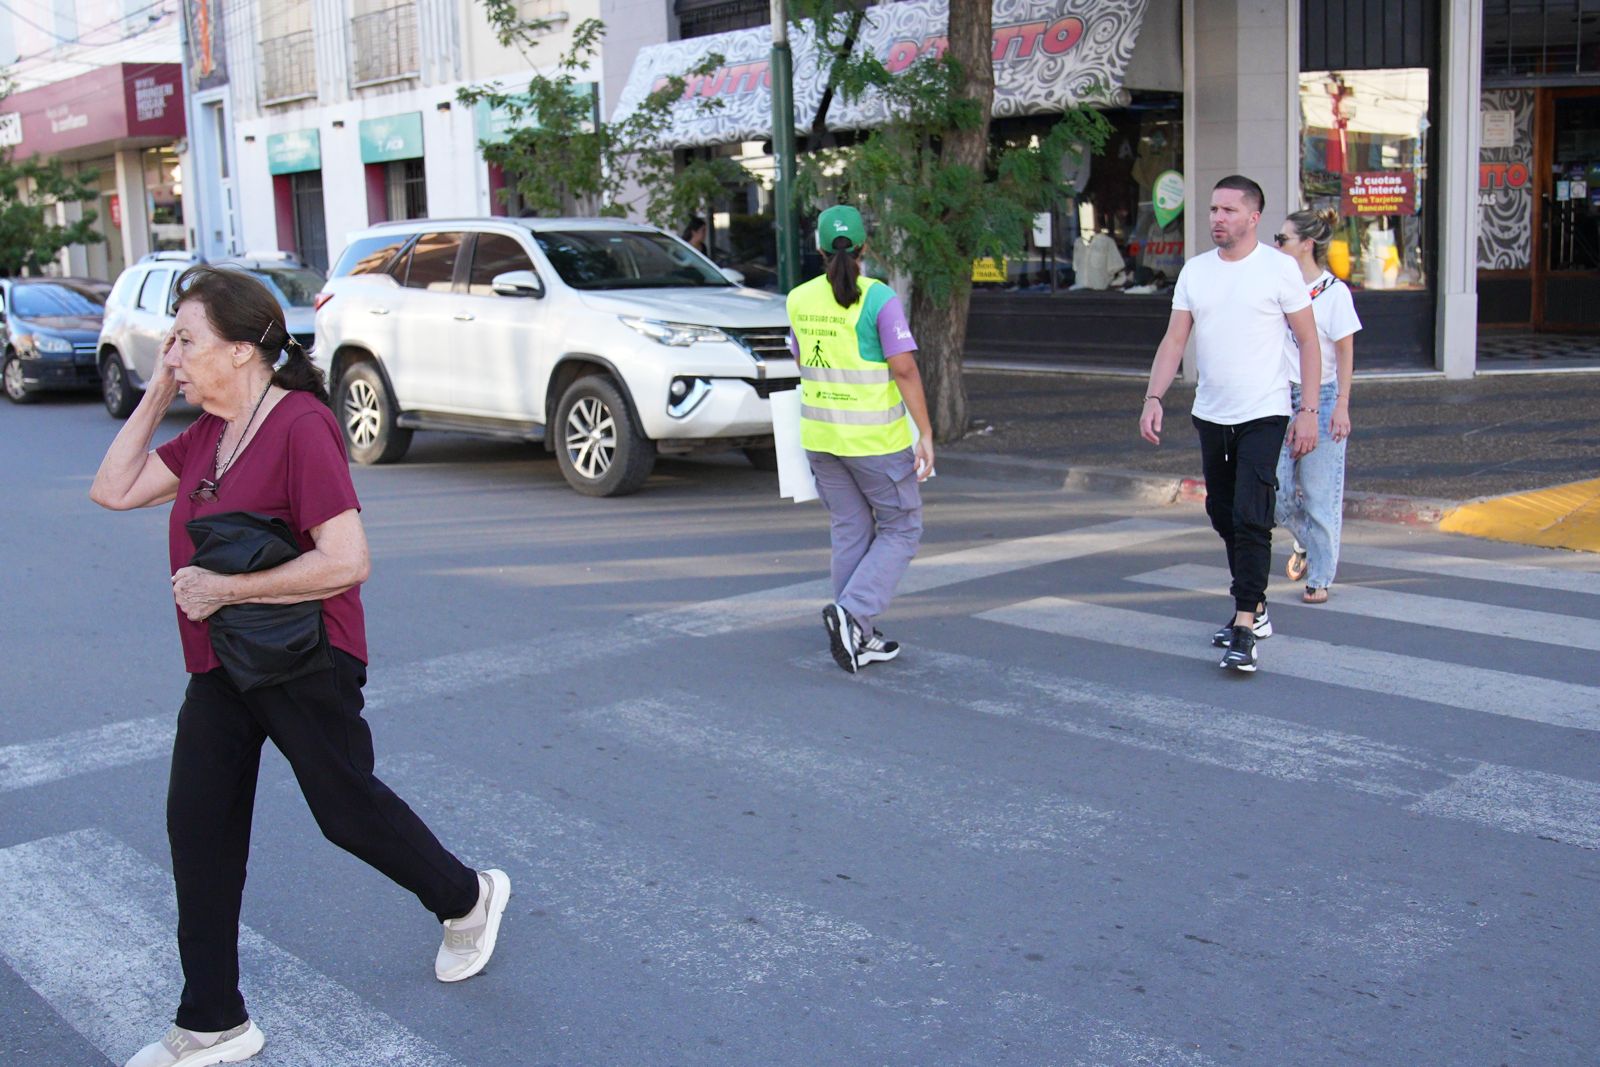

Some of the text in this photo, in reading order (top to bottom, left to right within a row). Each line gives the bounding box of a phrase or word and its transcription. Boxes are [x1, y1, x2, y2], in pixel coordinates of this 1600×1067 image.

[652, 60, 772, 101] TUTT
[1478, 161, 1528, 188] TTO
[1354, 176, 1402, 185] 3 cuotas
[1349, 186, 1366, 195] sin
[1352, 196, 1404, 204] Con Tarjetas
[1357, 204, 1398, 212] Bancarias
